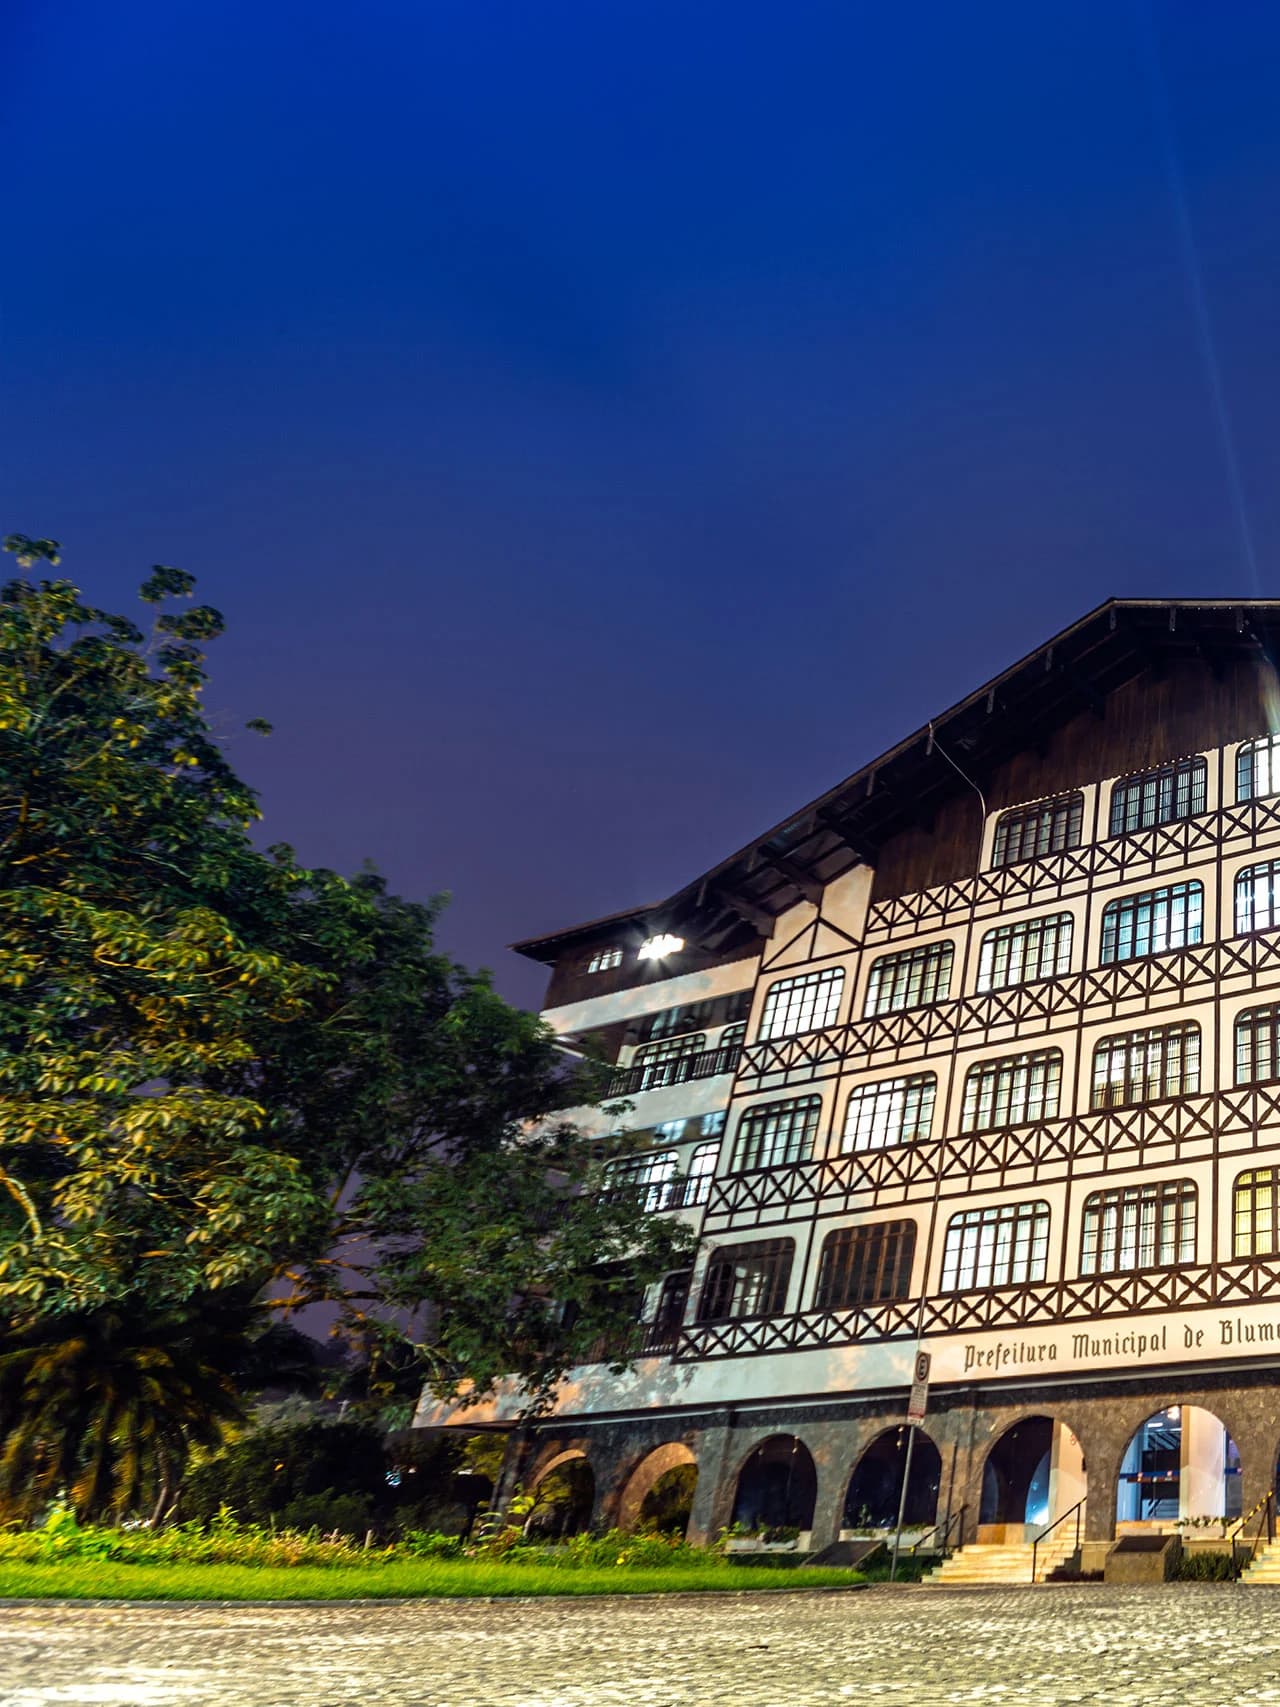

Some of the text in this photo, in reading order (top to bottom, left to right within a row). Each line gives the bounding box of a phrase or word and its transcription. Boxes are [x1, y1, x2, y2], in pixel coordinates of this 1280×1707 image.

[964, 1342, 1057, 1373] Prefeitura
[1072, 1325, 1167, 1359] Municipal
[1184, 1324, 1204, 1349] de
